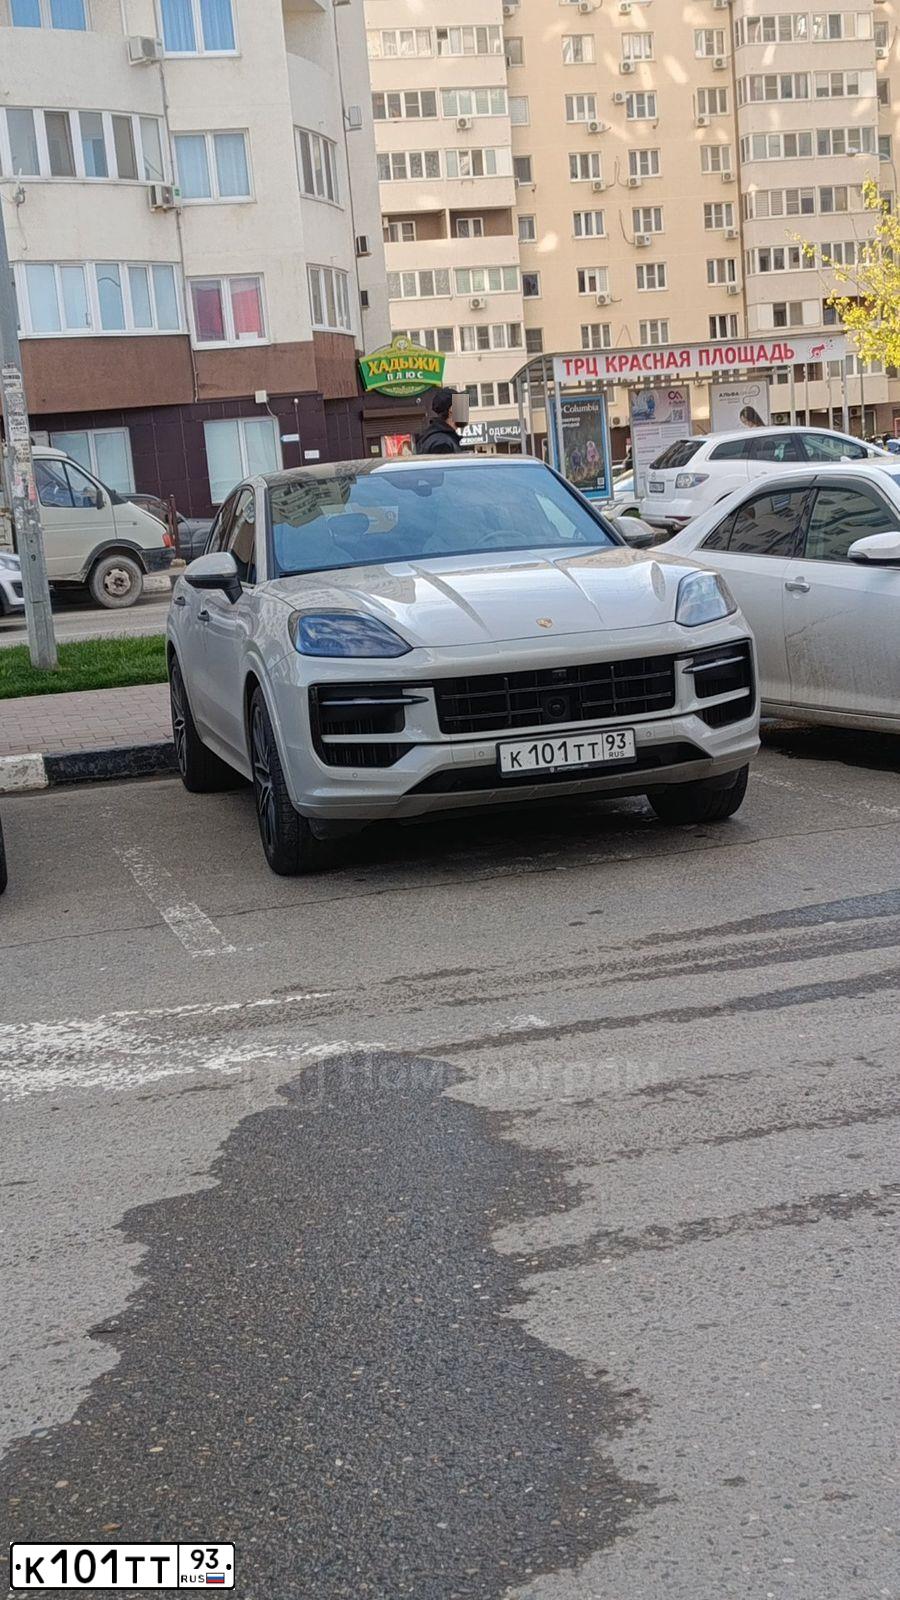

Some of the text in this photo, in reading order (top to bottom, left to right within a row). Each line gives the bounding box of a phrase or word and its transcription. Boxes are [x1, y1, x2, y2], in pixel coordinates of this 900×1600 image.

[368, 356, 440, 377] ХАДЫЖИ
[562, 343, 795, 377] ТРЦ КРАСНАЯ ПЛОЩАДЬ
[387, 371, 424, 381] ПЛЮС
[563, 403, 599, 413] Columbia
[510, 733, 626, 768] К101ТТ 93
